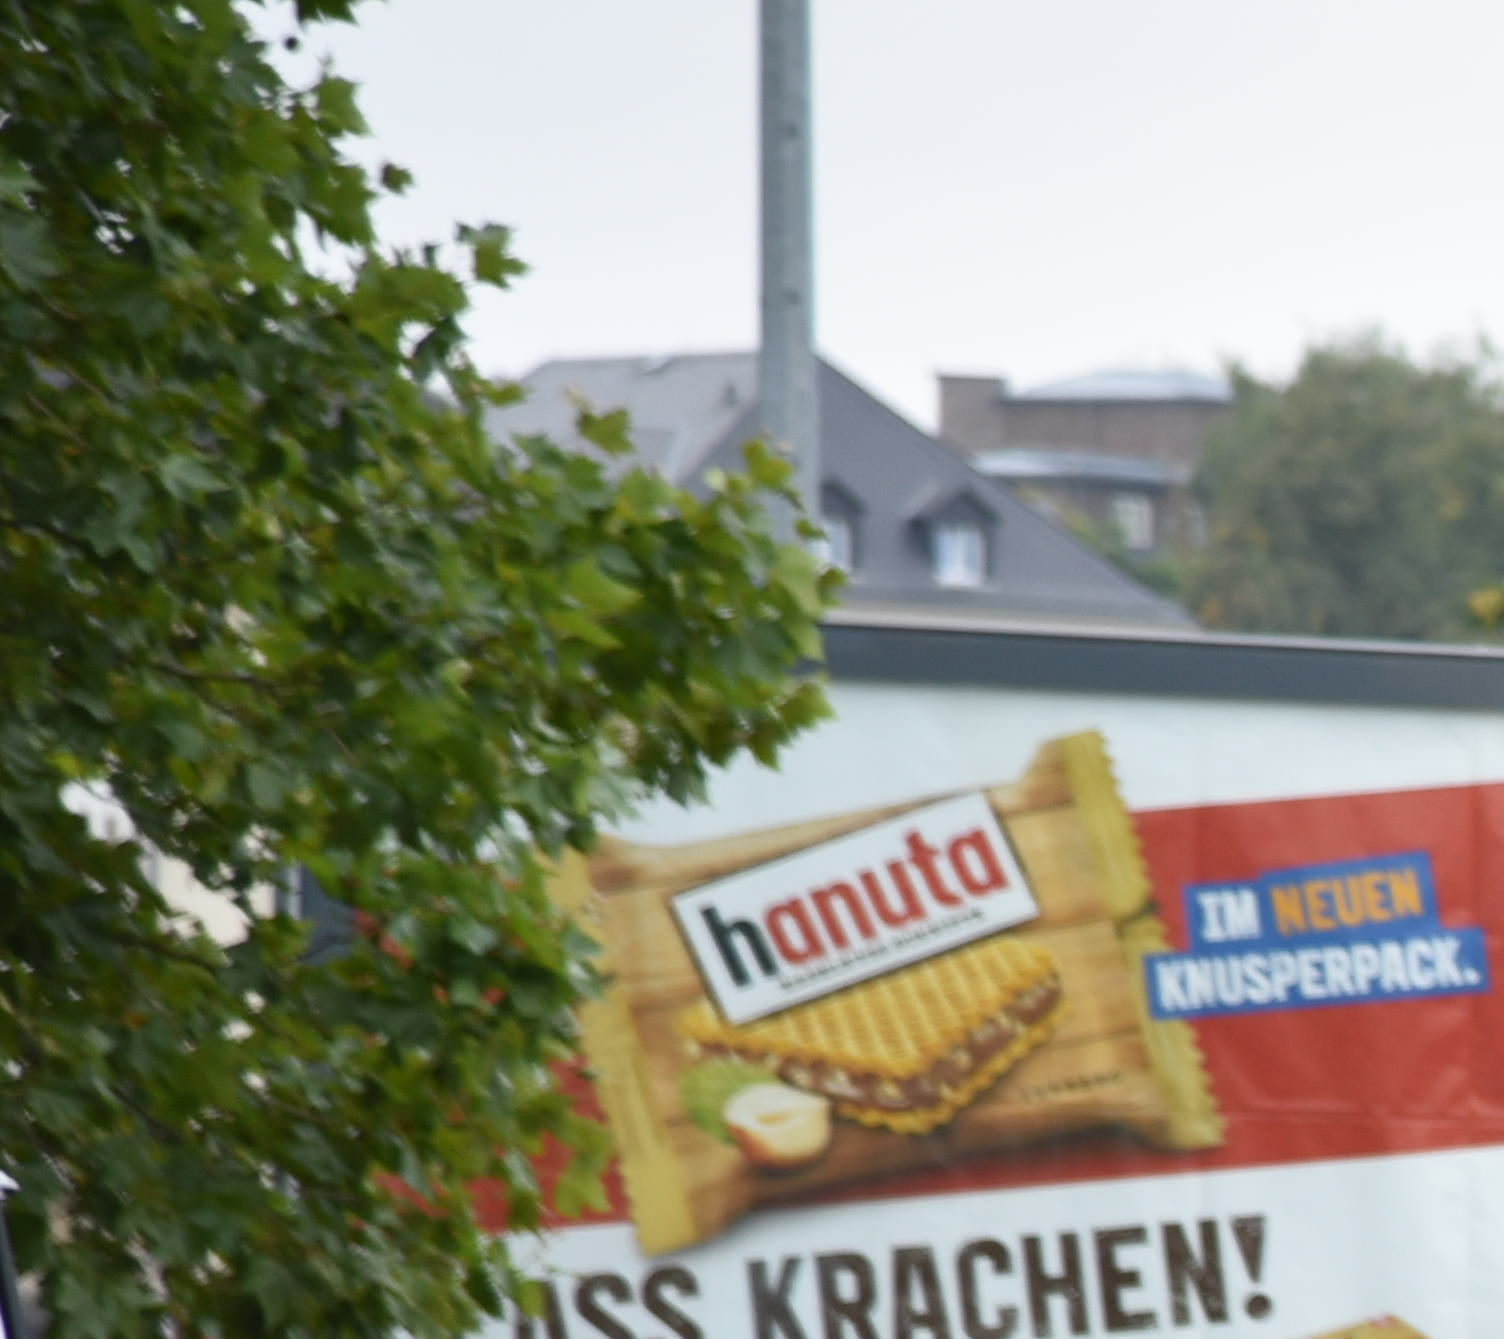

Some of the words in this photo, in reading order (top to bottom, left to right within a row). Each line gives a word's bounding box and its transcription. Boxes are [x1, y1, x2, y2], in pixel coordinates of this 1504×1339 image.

[701, 829, 1009, 987] hanuta
[1197, 887, 1263, 943] IM
[1270, 868, 1425, 937] NEUEN
[1154, 935, 1482, 1012] KNUSPERPACK.
